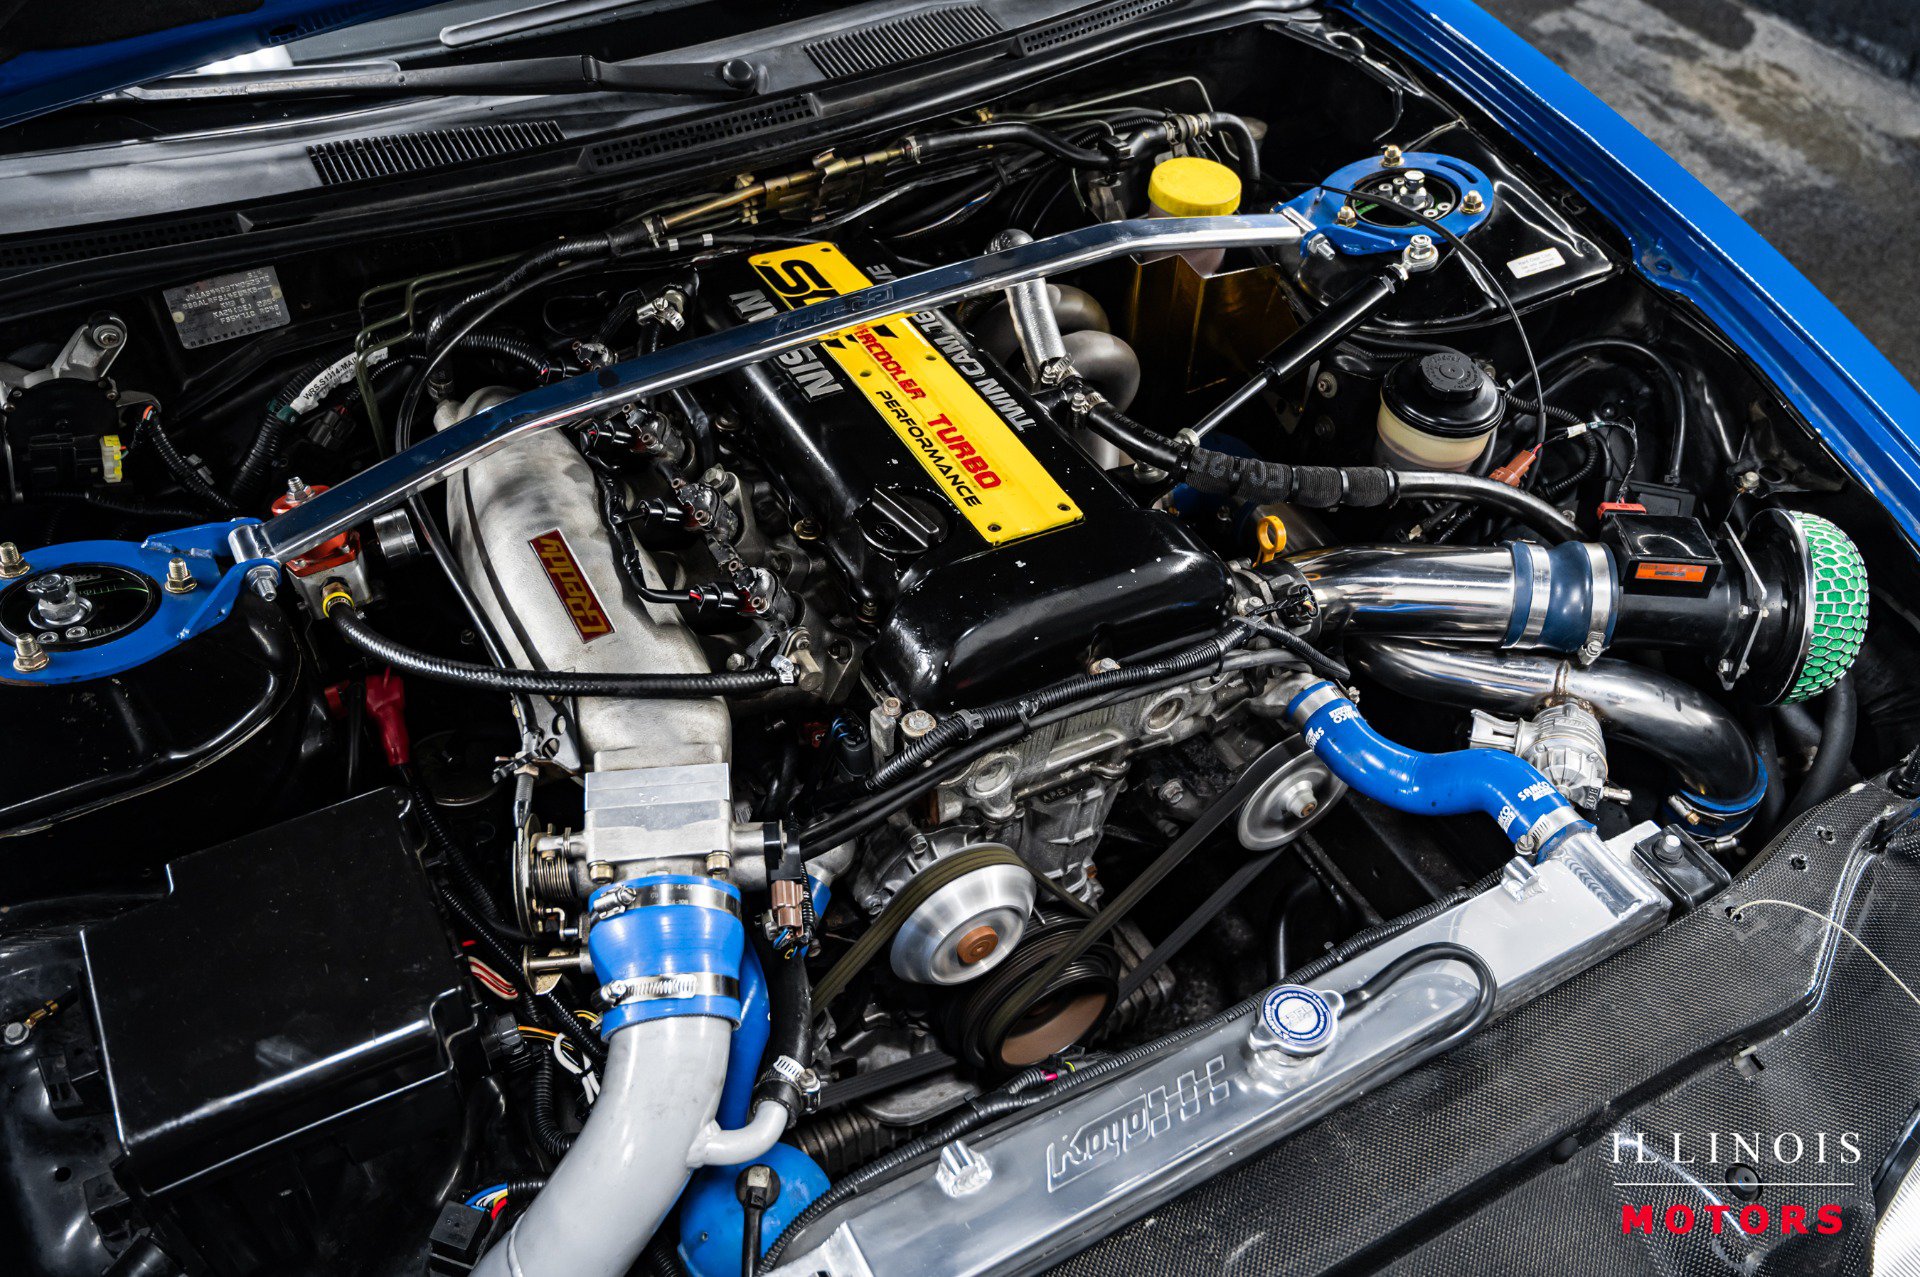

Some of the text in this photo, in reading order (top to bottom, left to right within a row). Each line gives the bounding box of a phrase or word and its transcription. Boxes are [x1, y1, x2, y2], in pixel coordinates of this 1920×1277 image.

[934, 333, 986, 381] CAM
[974, 377, 1037, 435] TWIN
[875, 391, 982, 509] PERFORMANCE
[926, 412, 1002, 491] TURBO
[1517, 781, 1550, 801] SAMCO
